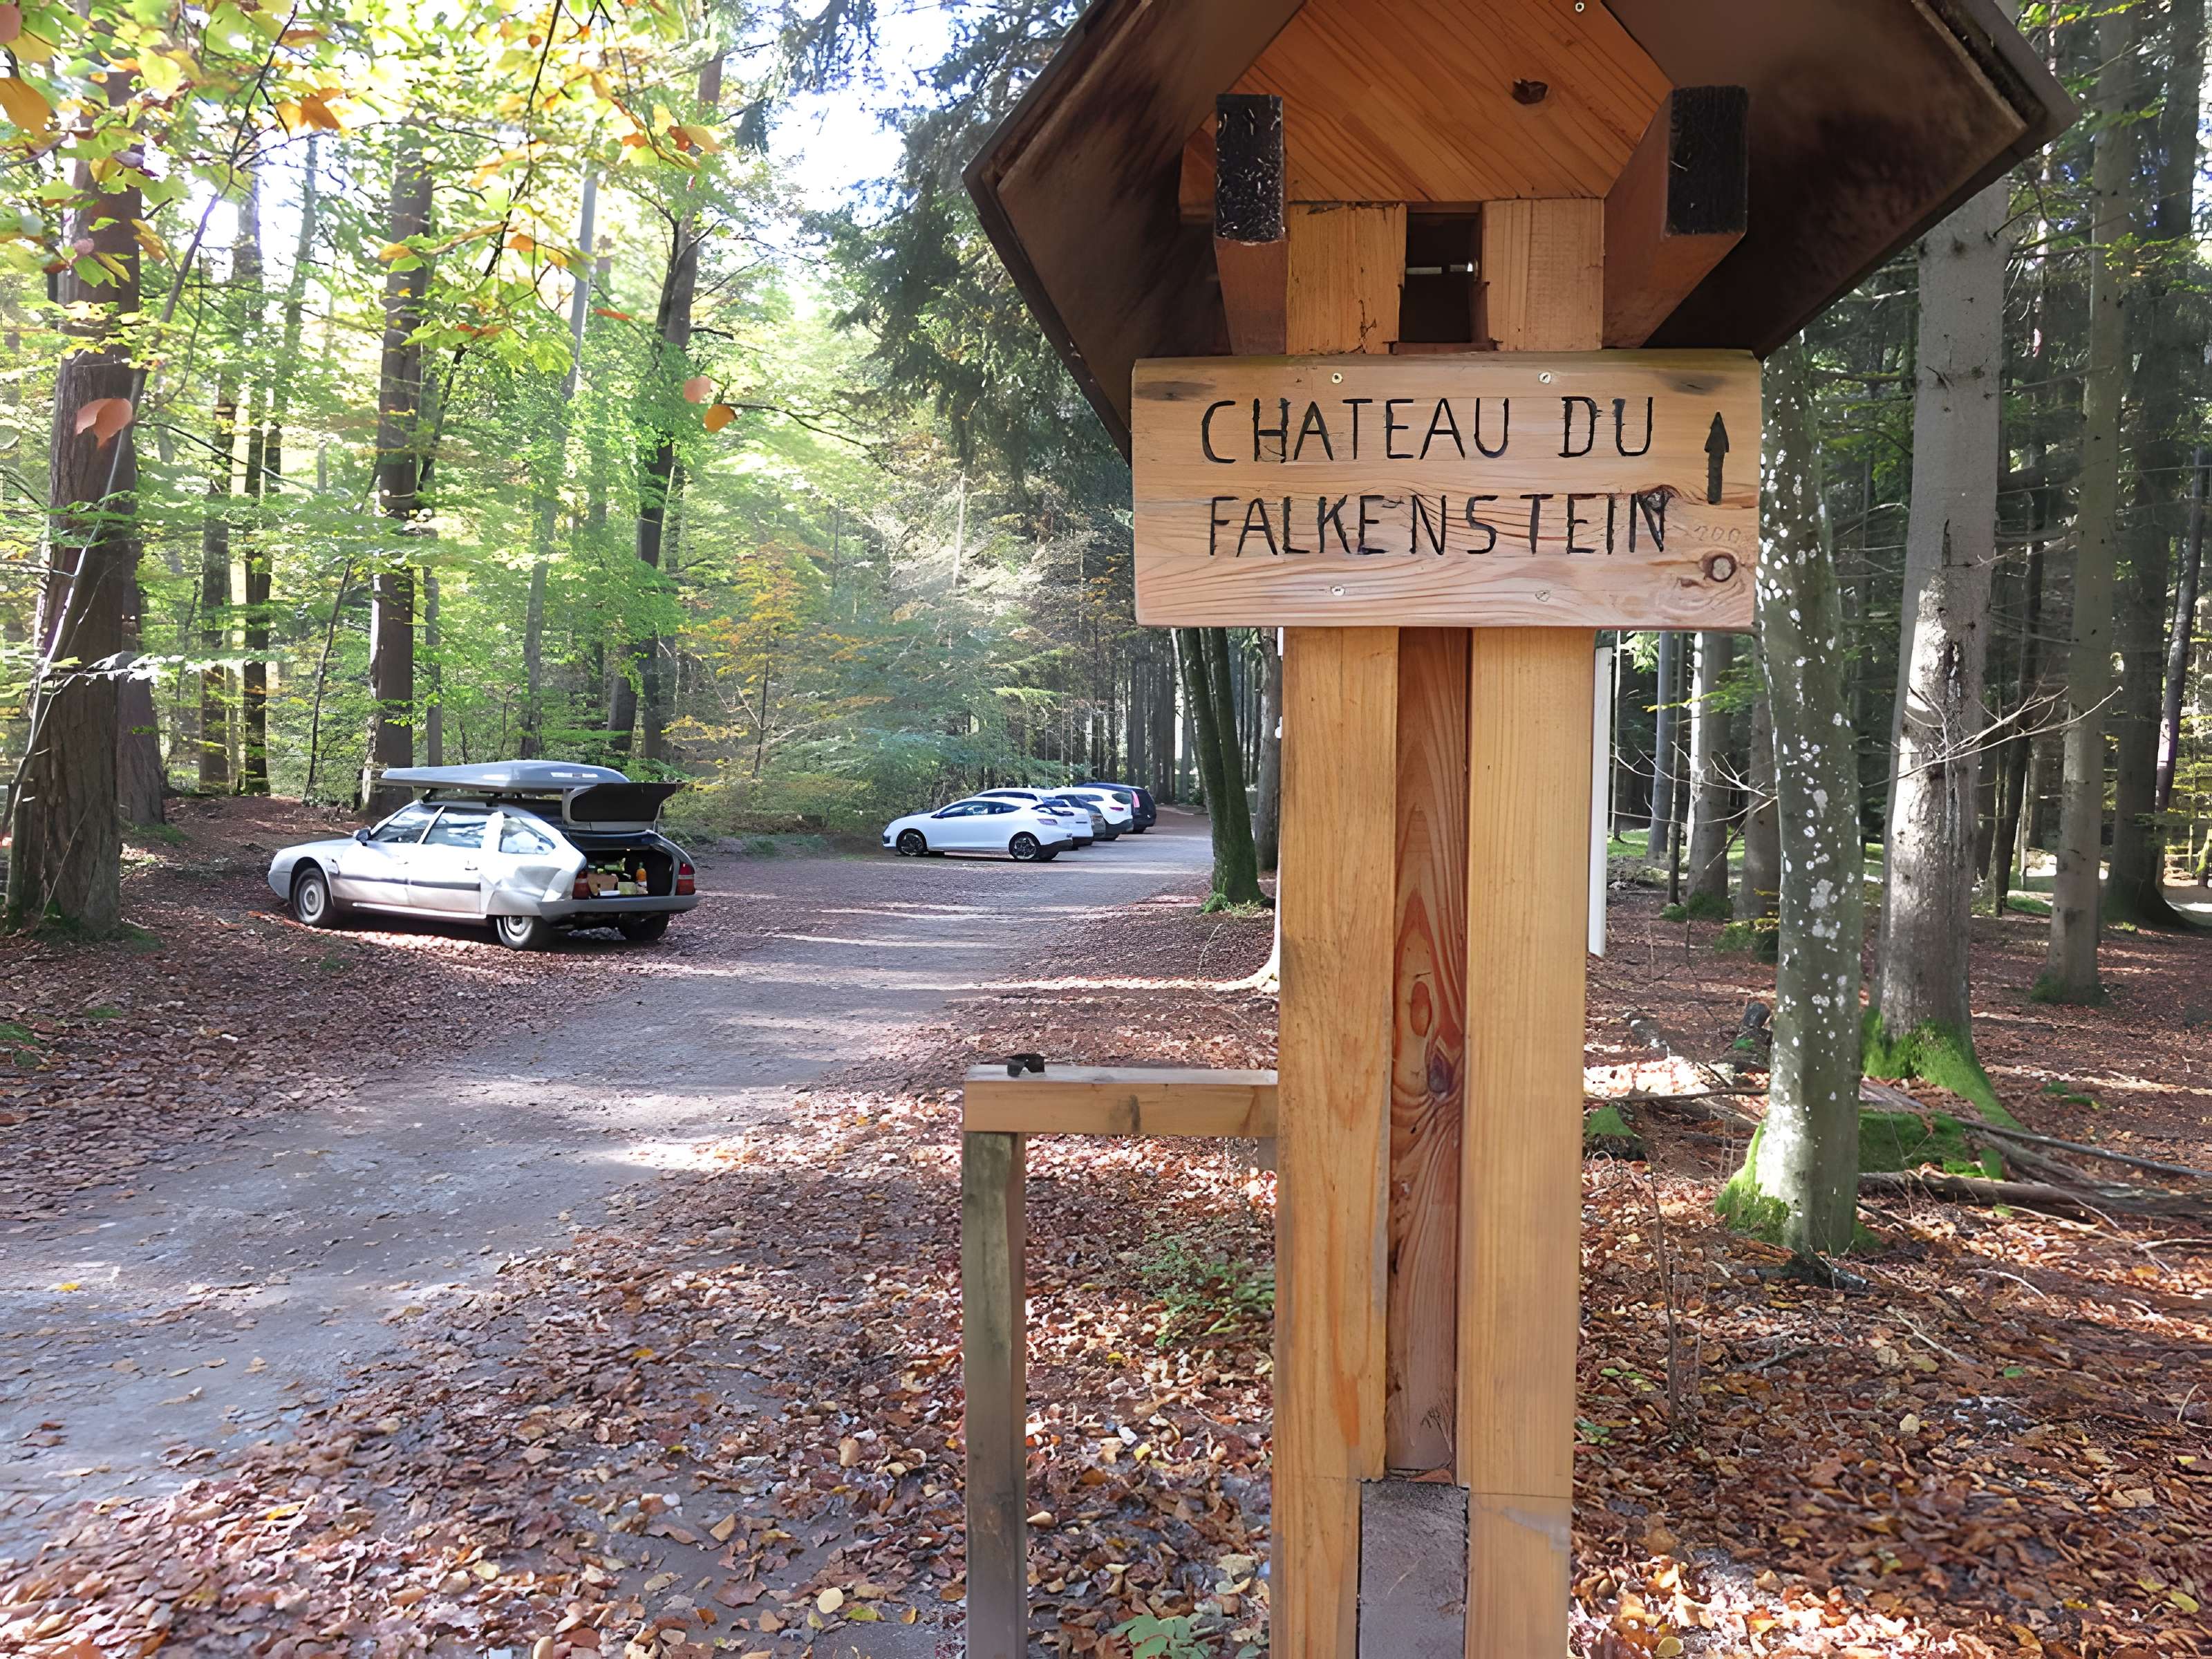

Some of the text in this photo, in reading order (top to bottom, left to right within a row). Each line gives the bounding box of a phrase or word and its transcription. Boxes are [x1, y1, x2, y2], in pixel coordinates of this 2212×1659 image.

[1201, 395, 1653, 463] CHATEAU DU
[1208, 493, 1665, 556] FALKENSTEIN
